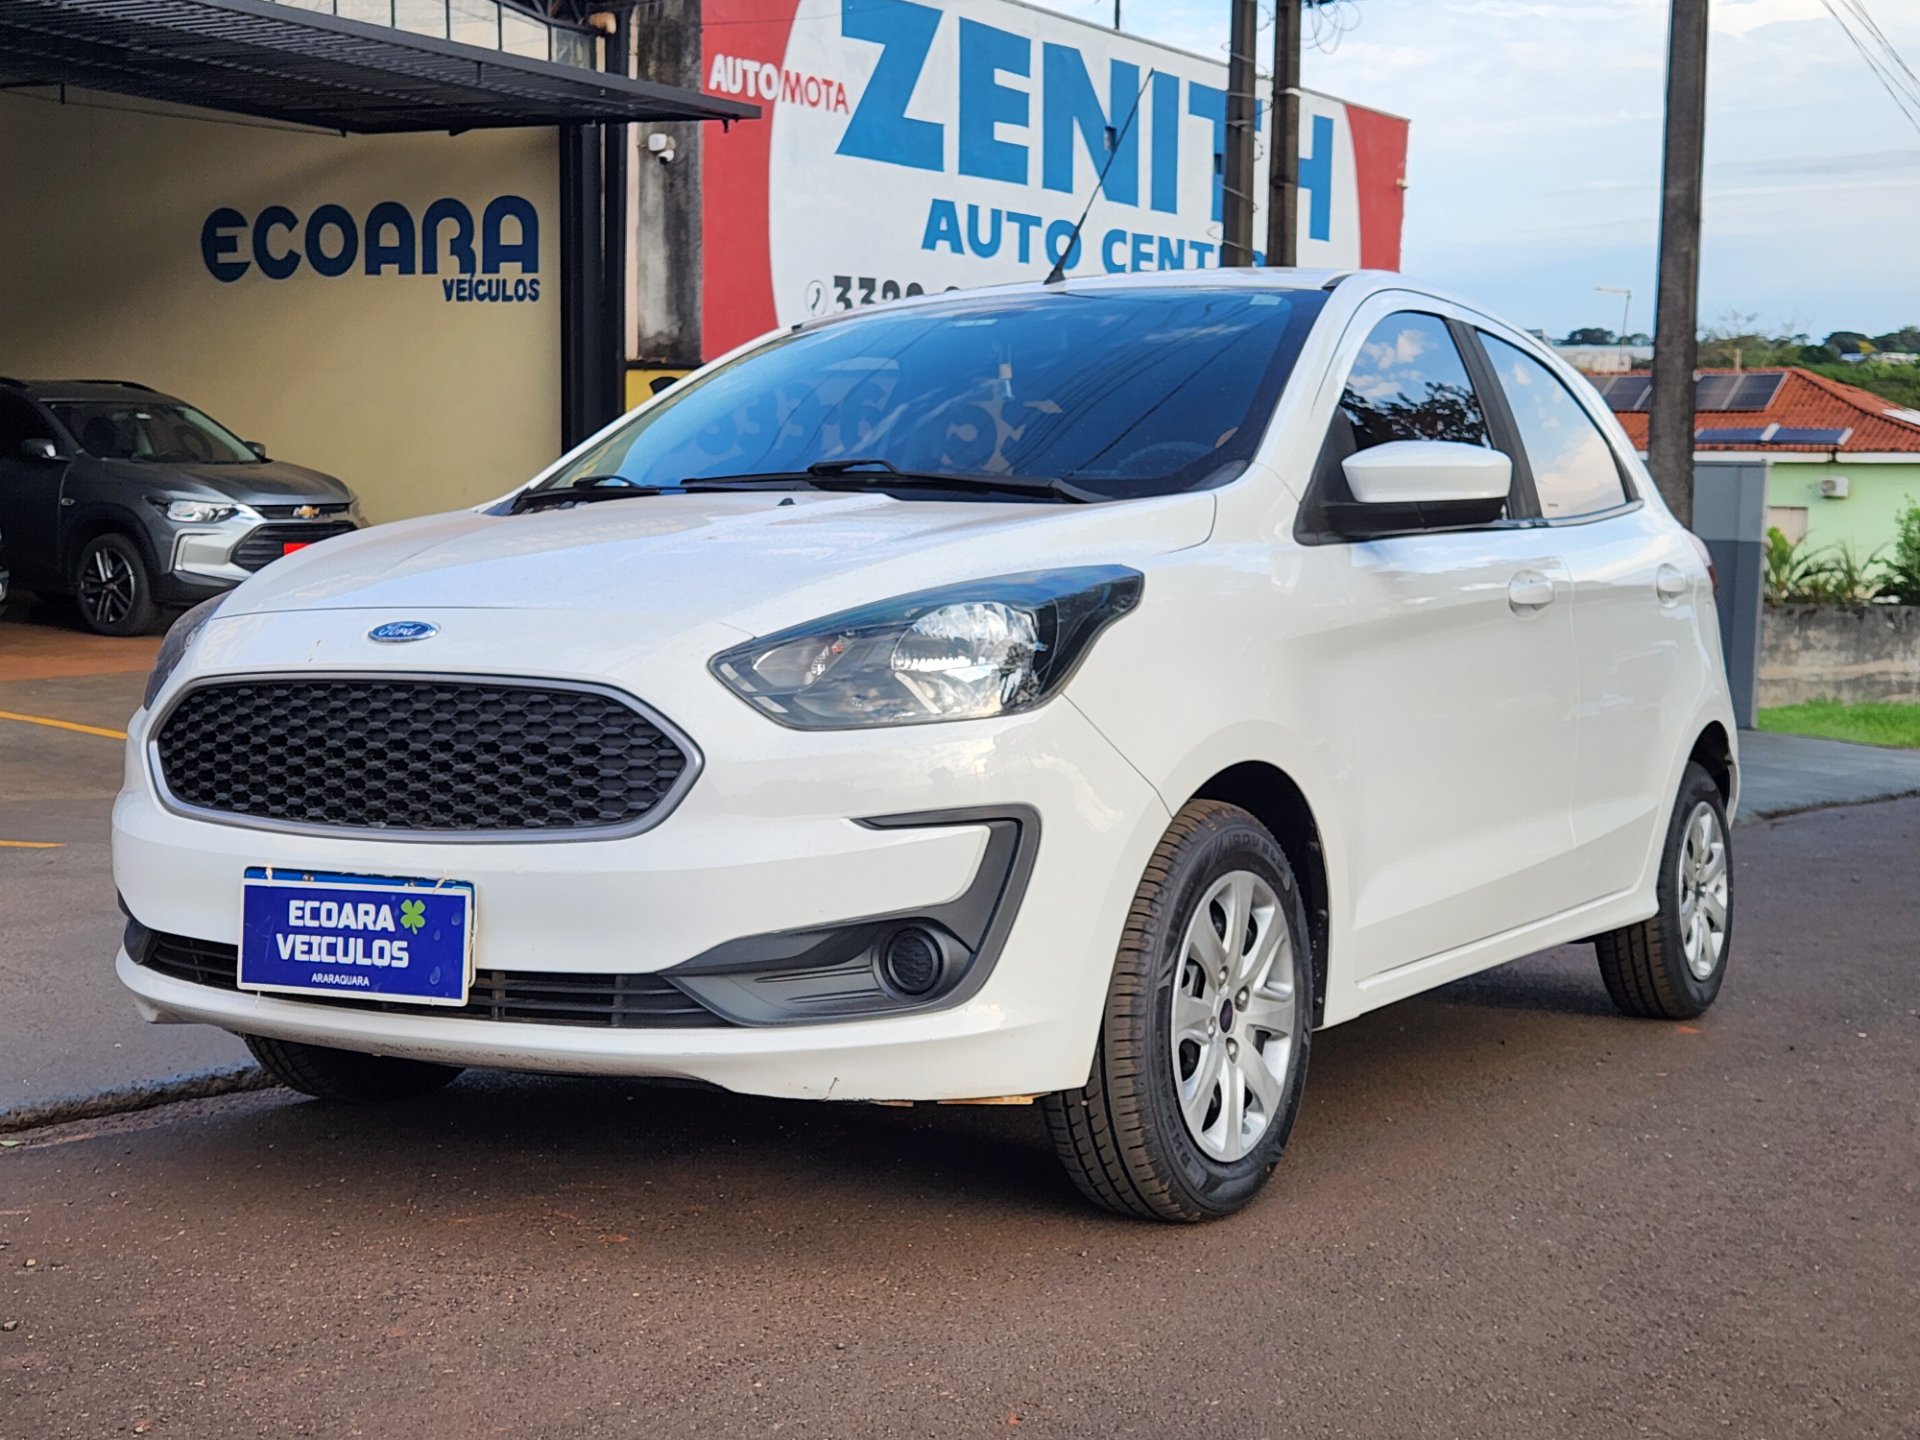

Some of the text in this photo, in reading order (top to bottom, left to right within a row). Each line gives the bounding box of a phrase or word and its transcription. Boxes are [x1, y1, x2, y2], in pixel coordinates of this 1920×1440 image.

[835, 0, 1335, 242] ZENITH
[201, 195, 539, 282] ECOARA
[922, 199, 1267, 274] AUTO CENT
[289, 900, 396, 932] ECOARA
[276, 933, 409, 968] VEICULOS
[311, 972, 371, 987] ARARAQUARA
